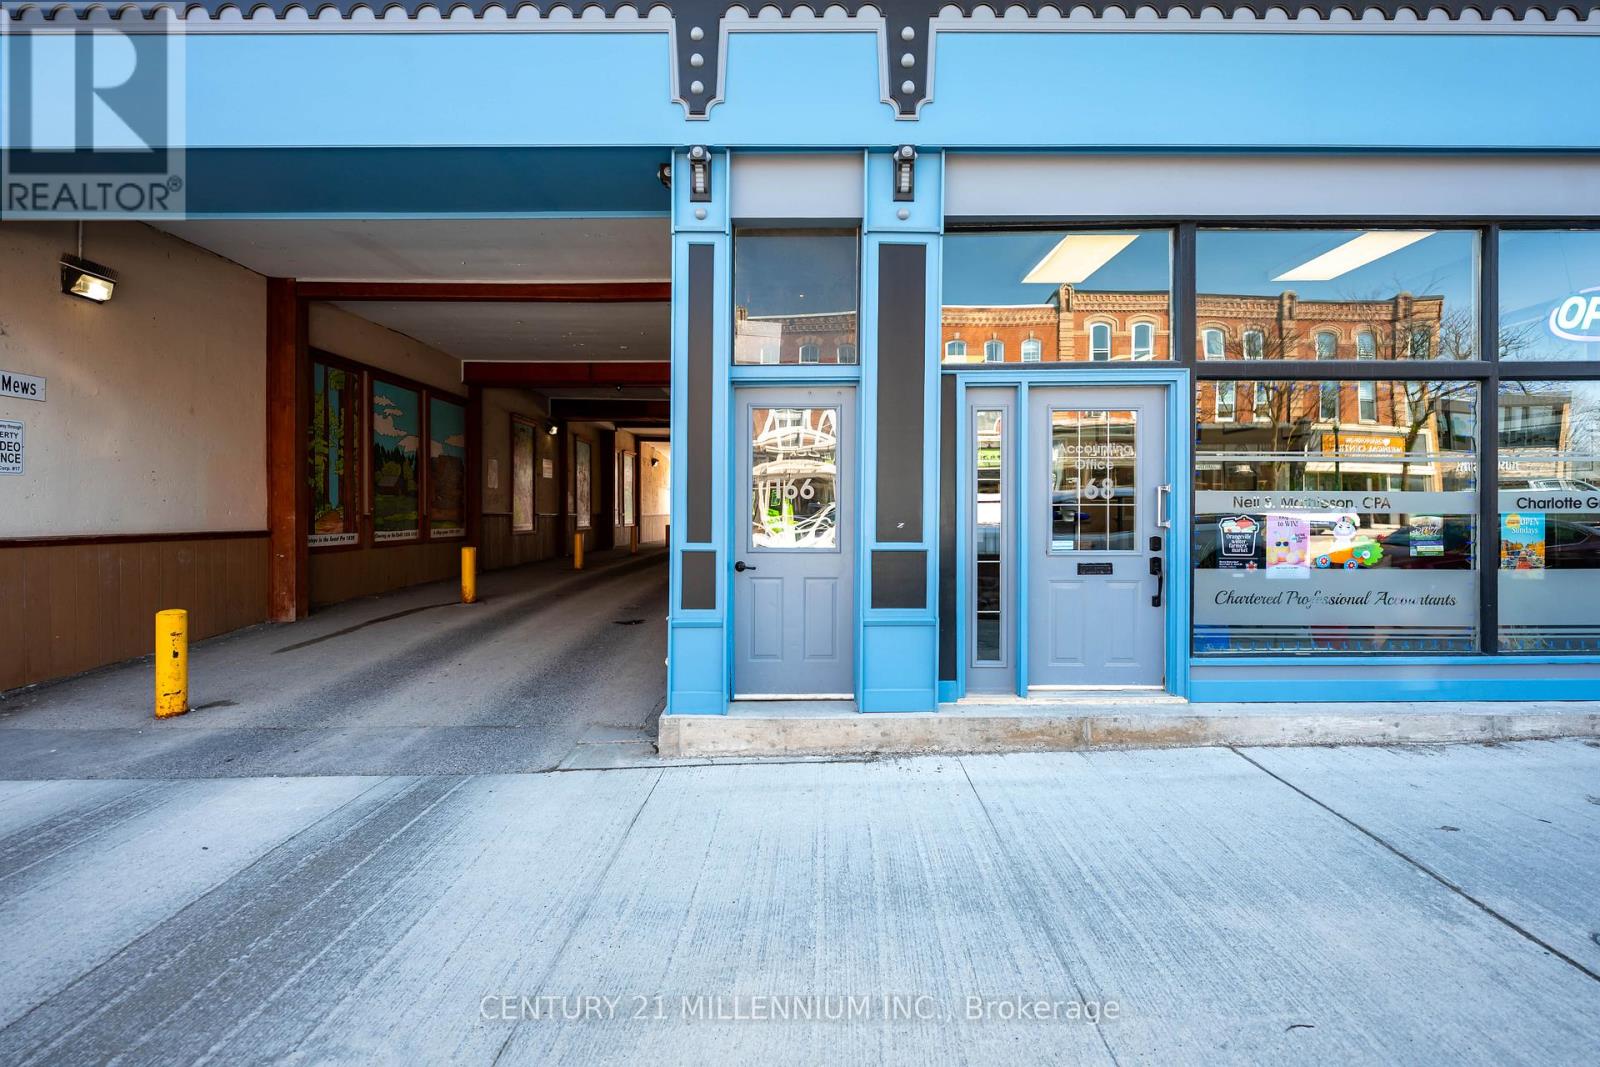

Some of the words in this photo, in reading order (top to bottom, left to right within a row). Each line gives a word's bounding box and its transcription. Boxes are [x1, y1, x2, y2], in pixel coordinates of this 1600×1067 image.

[1, 374, 37, 396] Mews
[0, 441, 21, 452] DEO
[1059, 442, 1134, 456] Accounting
[0, 453, 21, 464] NCE
[1074, 458, 1115, 471] Office
[776, 478, 815, 500] 166
[1074, 477, 1115, 500] 168
[1233, 496, 1260, 508] Neil
[1264, 496, 1276, 509] S.
[1362, 496, 1391, 509] CPA
[1516, 497, 1582, 509] Charlotte
[1214, 590, 1283, 605] Chartered
